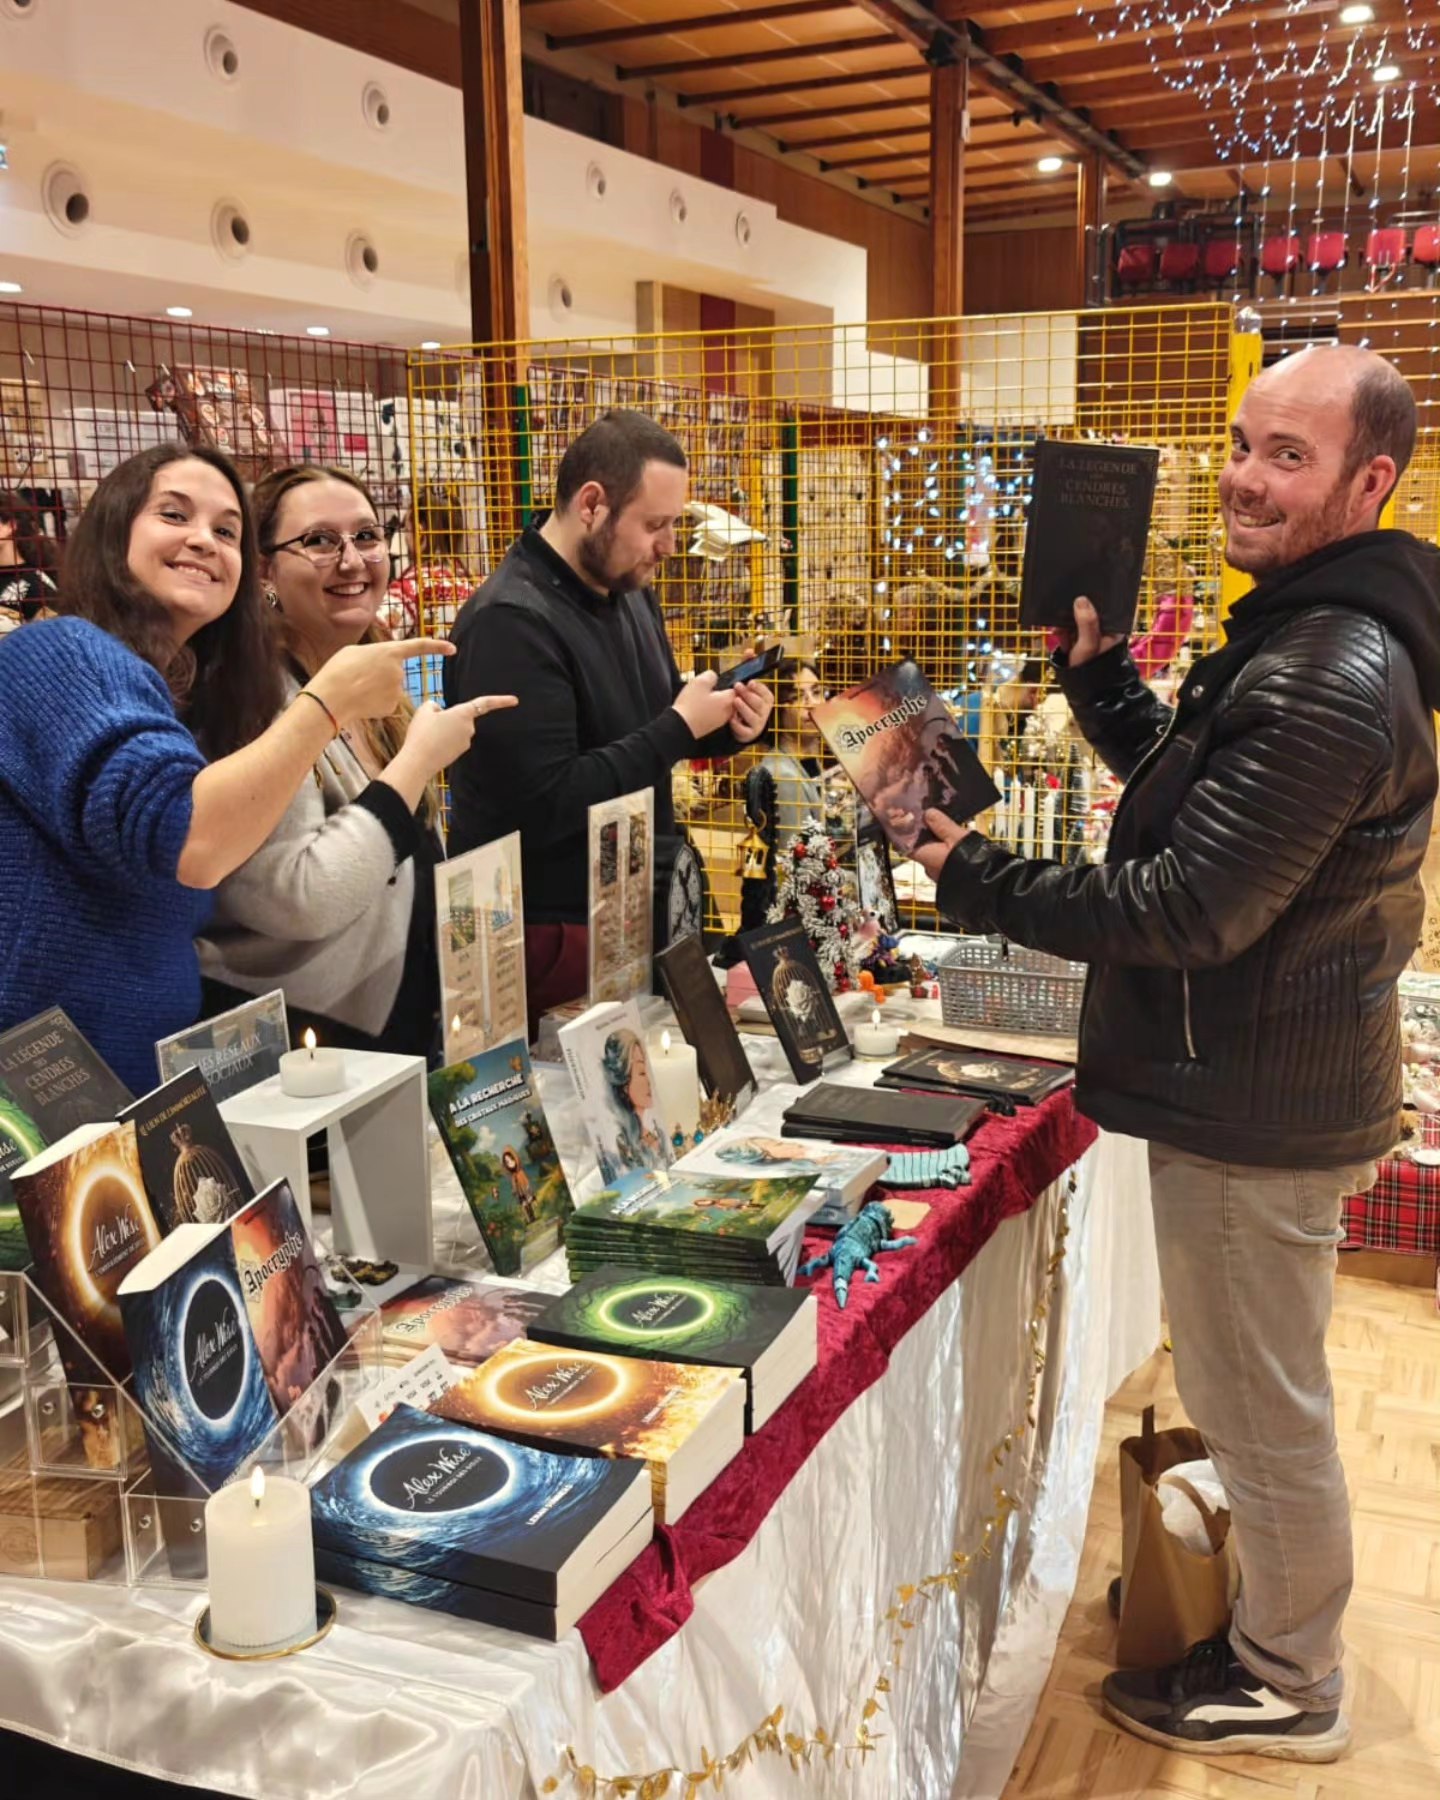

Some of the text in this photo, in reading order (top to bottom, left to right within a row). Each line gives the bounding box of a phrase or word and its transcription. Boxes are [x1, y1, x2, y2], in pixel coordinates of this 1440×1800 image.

[842, 695, 927, 748] Apocryphe
[1, 1052, 18, 1072] LA
[25, 1055, 77, 1090] CENDRES
[34, 1067, 91, 1107] BLANCHES
[457, 1096, 472, 1110] LA
[470, 1073, 524, 1104] RECHERCHE
[87, 1223, 118, 1272] Alex
[115, 1203, 140, 1245] Wise
[244, 1231, 303, 1294] Apocryphe
[396, 1286, 473, 1333] Apocryphe
[631, 1306, 661, 1329] Alex
[189, 1332, 217, 1382] Alex
[214, 1306, 238, 1351] Wise
[525, 1381, 561, 1411] Alex
[547, 1362, 585, 1384] Wise
[402, 1444, 472, 1510] Alex Wise
